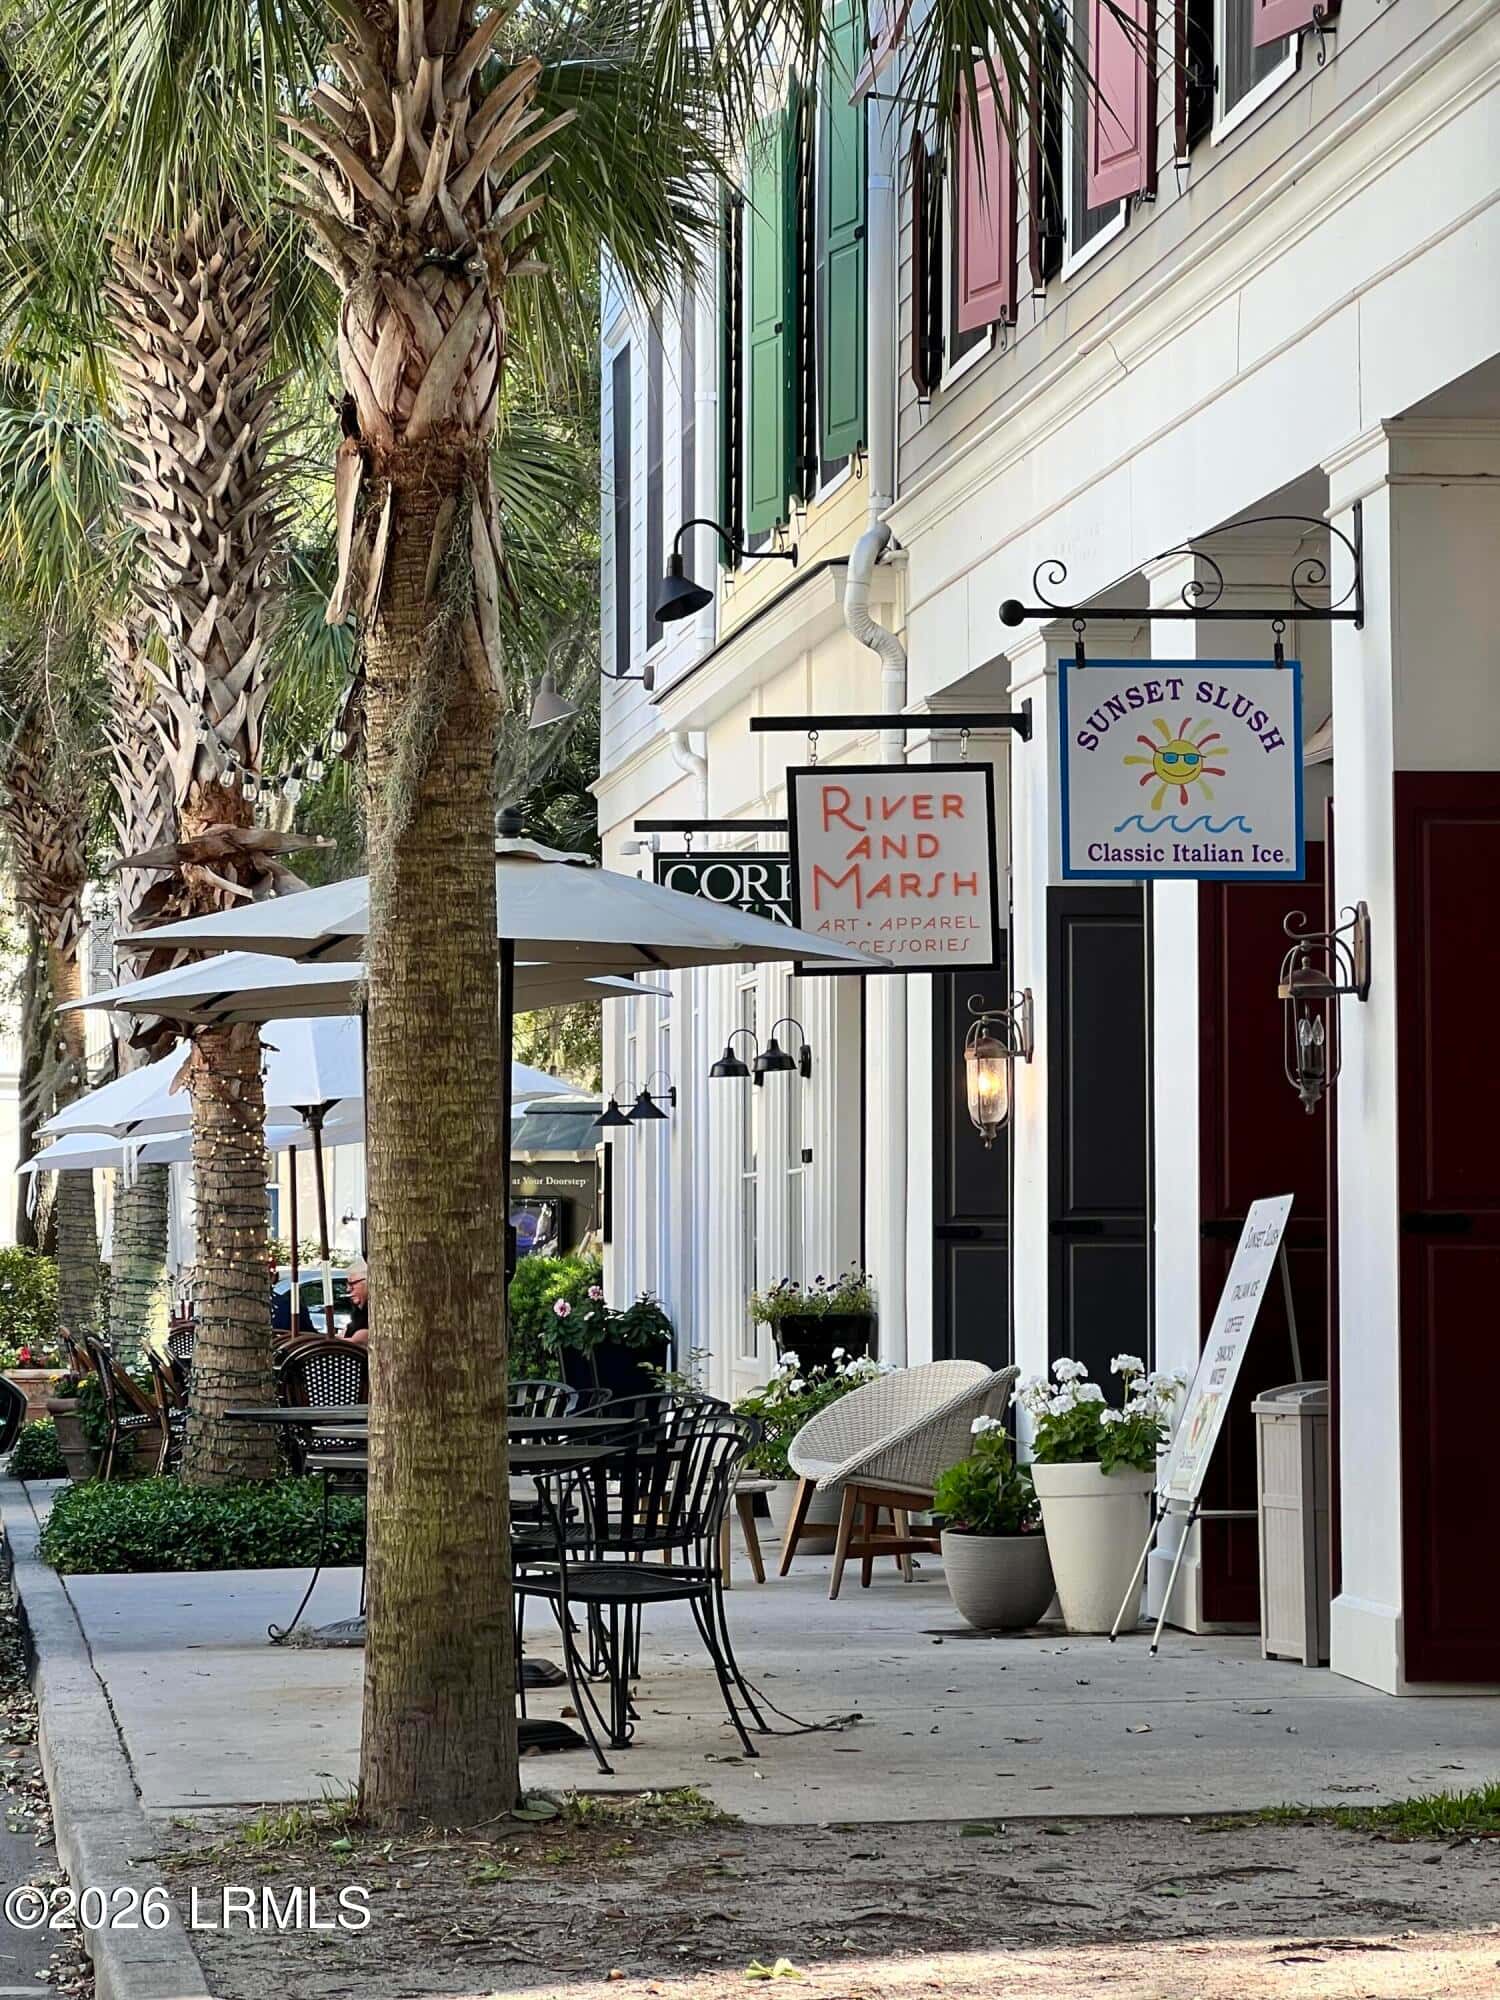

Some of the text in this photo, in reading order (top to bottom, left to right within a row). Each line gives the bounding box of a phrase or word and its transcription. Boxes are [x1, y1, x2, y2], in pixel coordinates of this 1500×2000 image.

[1077, 678, 1285, 754] SUNSET SLUSH
[821, 785, 966, 832] RIVER
[846, 833, 941, 860] AND
[1087, 843, 1165, 862] Classic
[1172, 843, 1244, 862] Italian
[812, 863, 979, 911] MARSH
[817, 915, 981, 932] ART APPAREL
[847, 938, 971, 953] CESSORIES
[522, 1176, 543, 1185] Your
[545, 1176, 586, 1188] Doorstep
